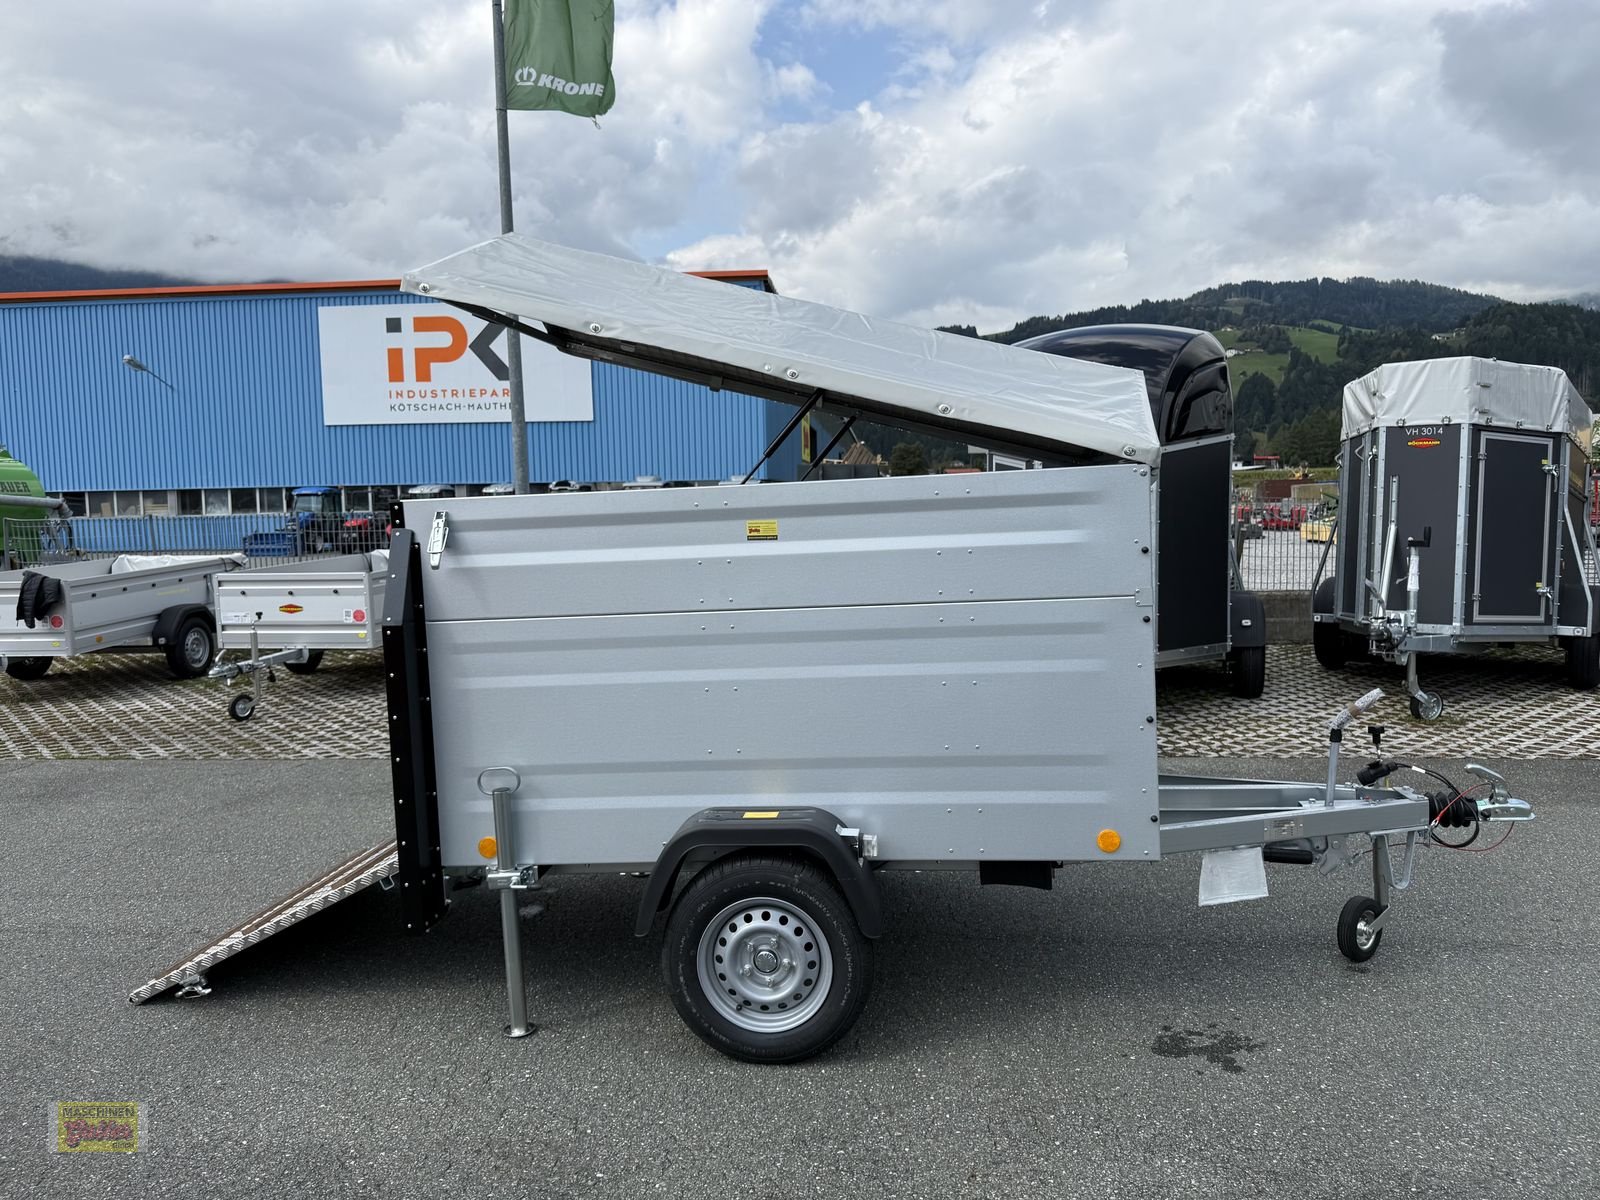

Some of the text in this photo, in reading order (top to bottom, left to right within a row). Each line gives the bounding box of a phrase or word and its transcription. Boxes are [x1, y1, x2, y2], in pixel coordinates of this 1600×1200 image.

[537, 73, 605, 97] KRONE
[389, 402, 512, 412] KÖTSCHACH-MAUTH
[1405, 426, 1443, 436] VH 3014
